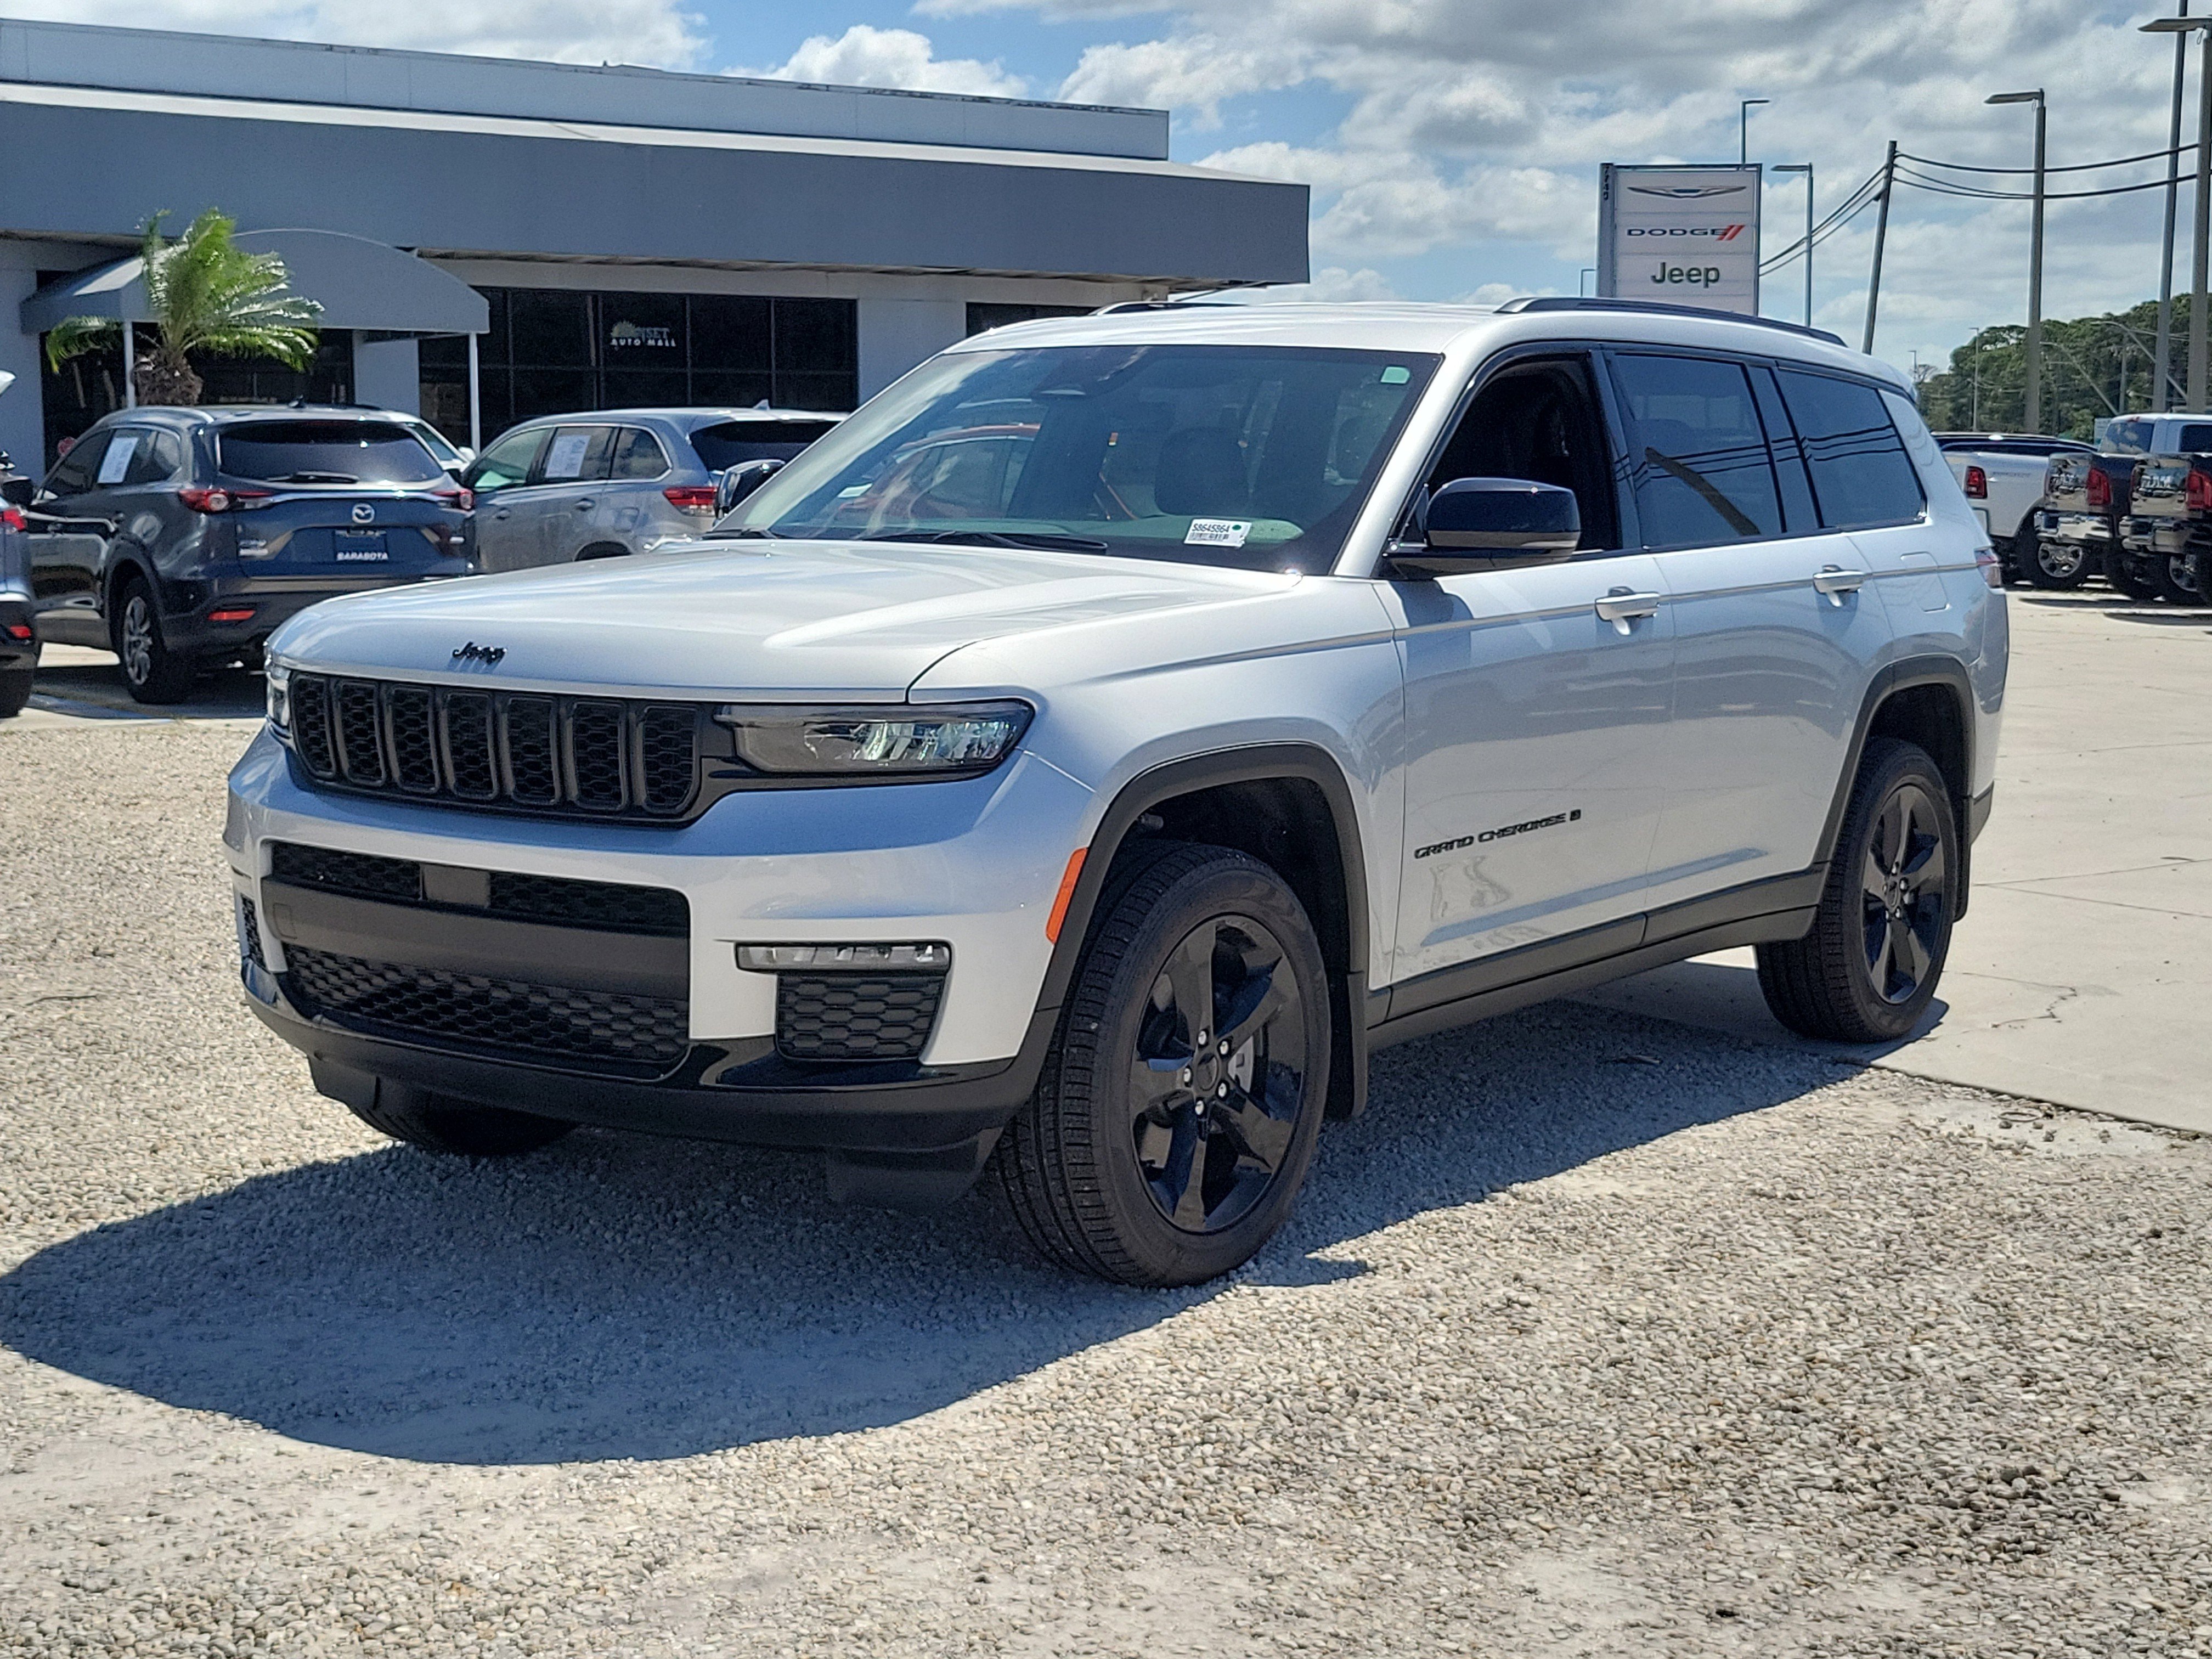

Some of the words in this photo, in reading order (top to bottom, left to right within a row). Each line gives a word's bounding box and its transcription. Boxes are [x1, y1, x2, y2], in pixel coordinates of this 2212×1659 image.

[1627, 228, 1727, 236] DODGE
[1651, 262, 1720, 289] Jeep
[610, 338, 641, 346] AUTO
[452, 641, 506, 665] Jeep
[1414, 835, 1474, 859] GRAND
[1477, 812, 1566, 843] CHEROKEE
